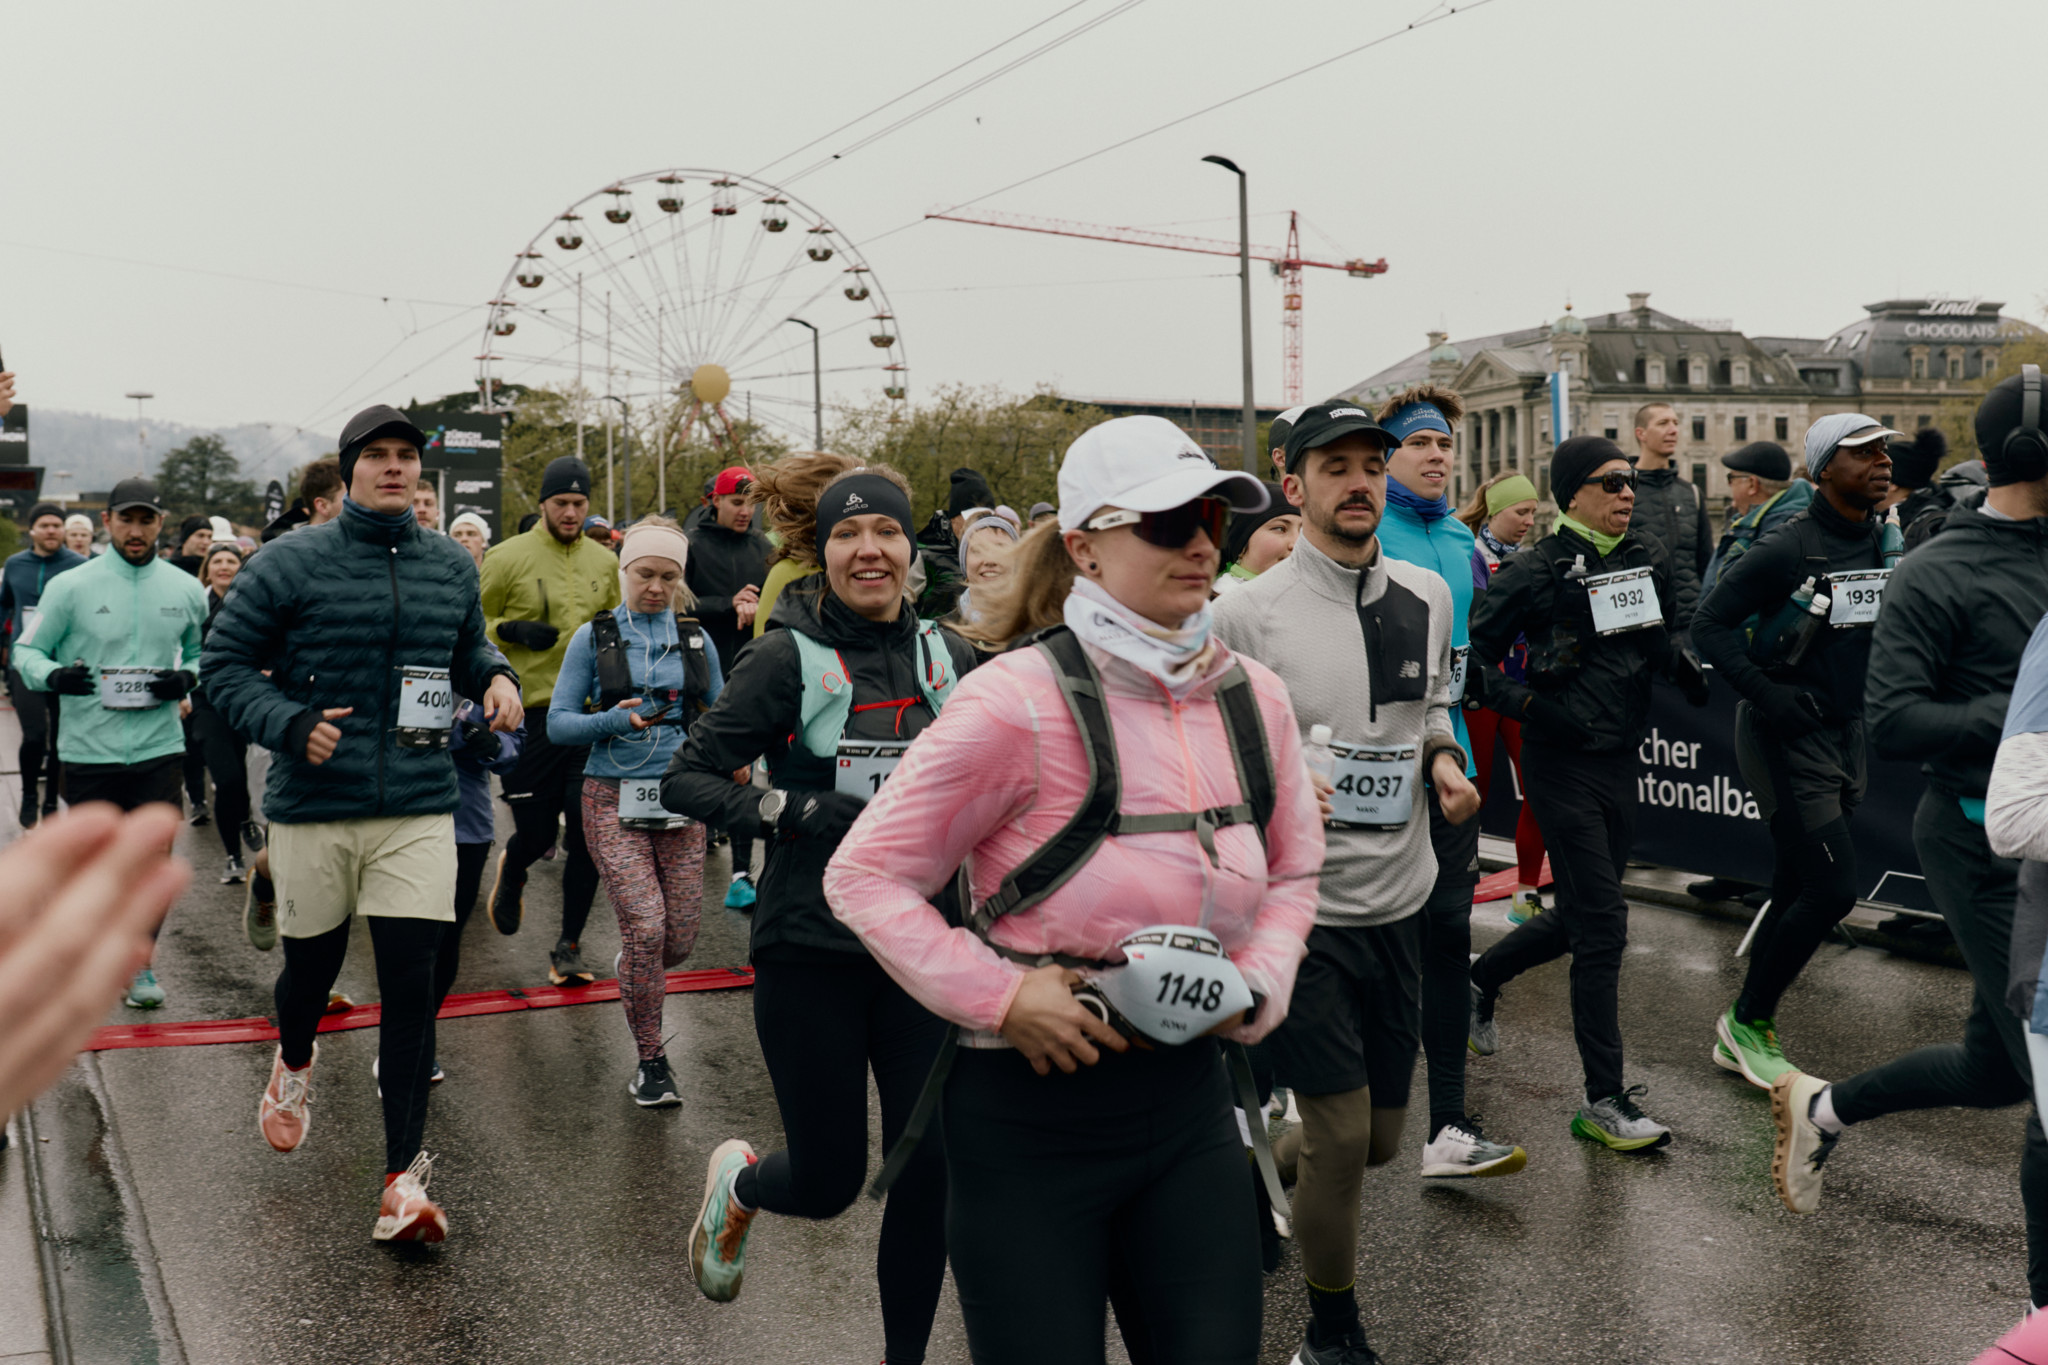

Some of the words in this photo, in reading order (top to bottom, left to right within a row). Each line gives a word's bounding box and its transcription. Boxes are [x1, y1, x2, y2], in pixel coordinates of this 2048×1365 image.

[1918, 294, 1983, 316] Lindt
[1904, 322, 1996, 338] CHOCOLATS
[444, 428, 482, 439] ZÜRICH
[444, 439, 501, 449] MARATHON
[1610, 589, 1644, 609] 1932
[1846, 589, 1884, 606] 1931
[1638, 727, 1702, 769] cher
[1336, 774, 1403, 797] 4037
[1156, 971, 1224, 1012] 1148
